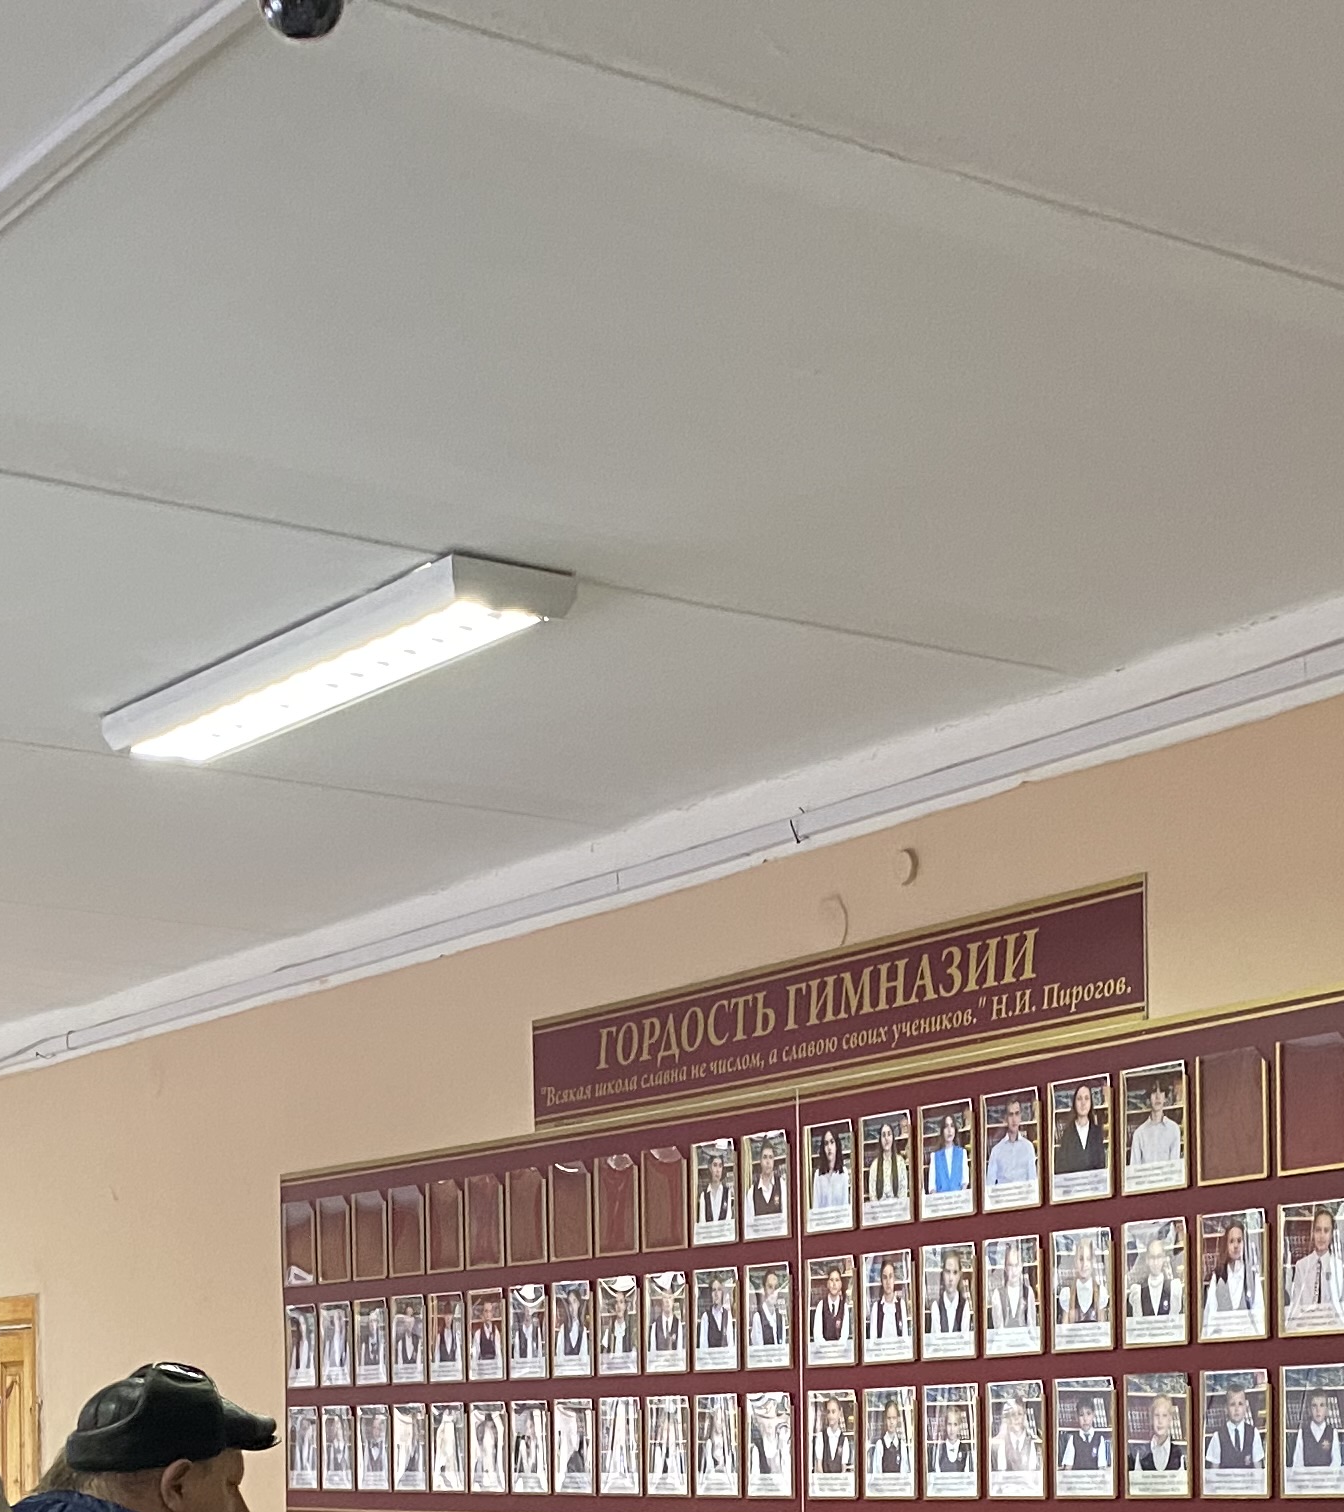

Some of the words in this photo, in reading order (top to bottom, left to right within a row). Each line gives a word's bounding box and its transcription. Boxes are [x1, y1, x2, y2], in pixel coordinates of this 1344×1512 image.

[595, 1076, 638, 1097] школа
[641, 1066, 687, 1087] славна
[691, 1063, 707, 1079] не
[710, 1054, 765, 1076] числом,
[768, 1049, 778, 1065] а
[782, 1037, 838, 1062] славою
[842, 1024, 889, 1050] своих
[1041, 976, 1132, 1013] Пирогов.
[596, 991, 776, 1070] ГОРДОСТЬ
[784, 928, 1040, 1031] ГИМНАЗИИ
